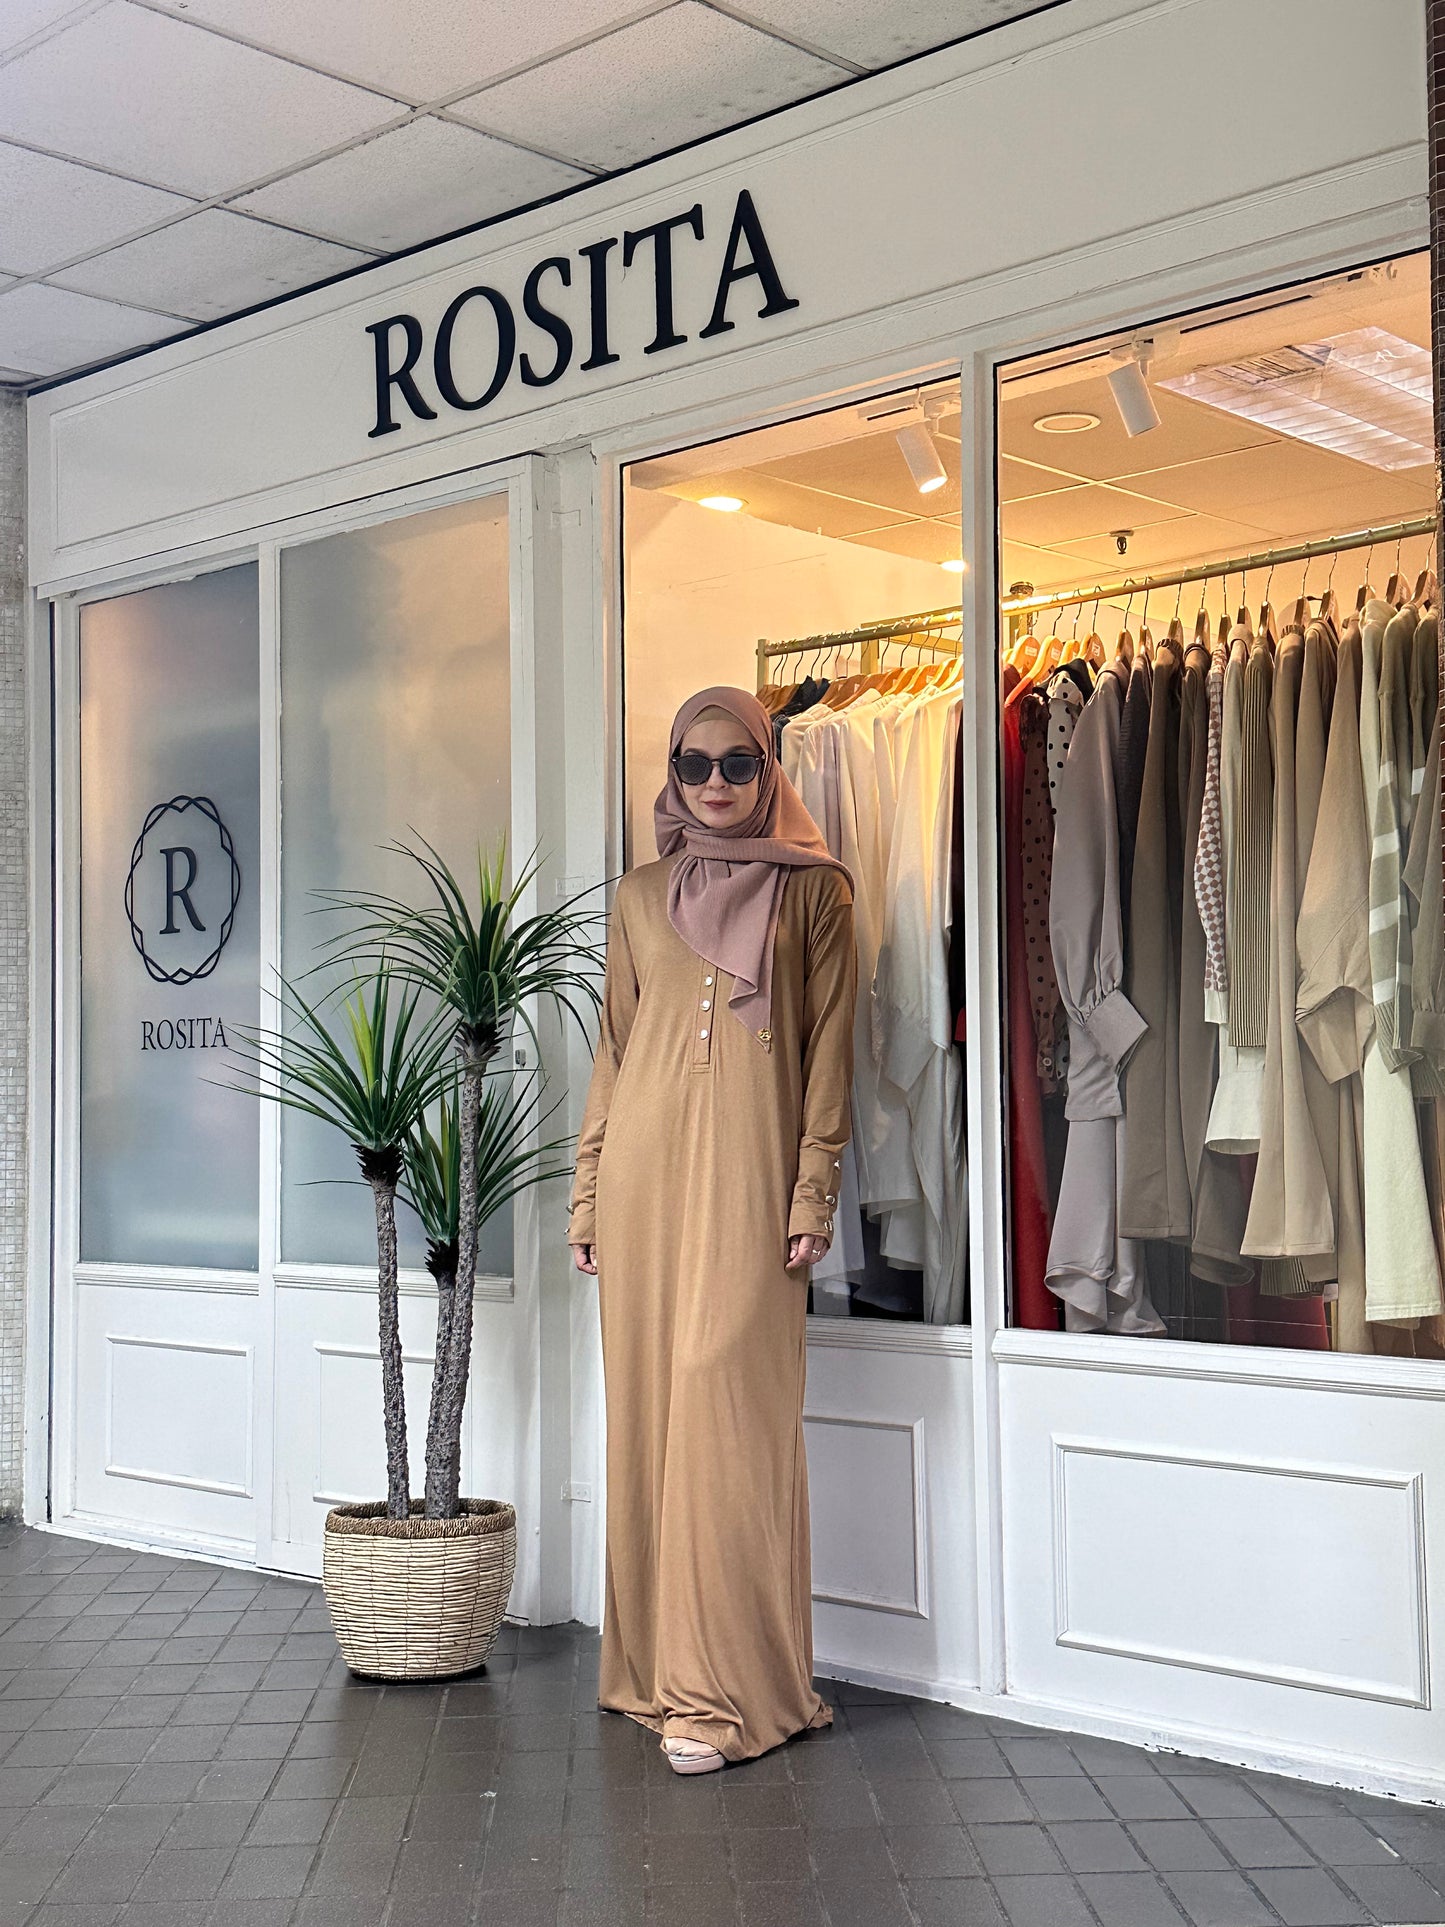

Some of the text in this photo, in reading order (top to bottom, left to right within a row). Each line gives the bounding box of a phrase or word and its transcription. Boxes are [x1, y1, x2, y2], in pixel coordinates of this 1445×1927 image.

[365, 189, 800, 439] ROSITA
[158, 846, 207, 935] R
[140, 1016, 229, 1051] ROSITA
